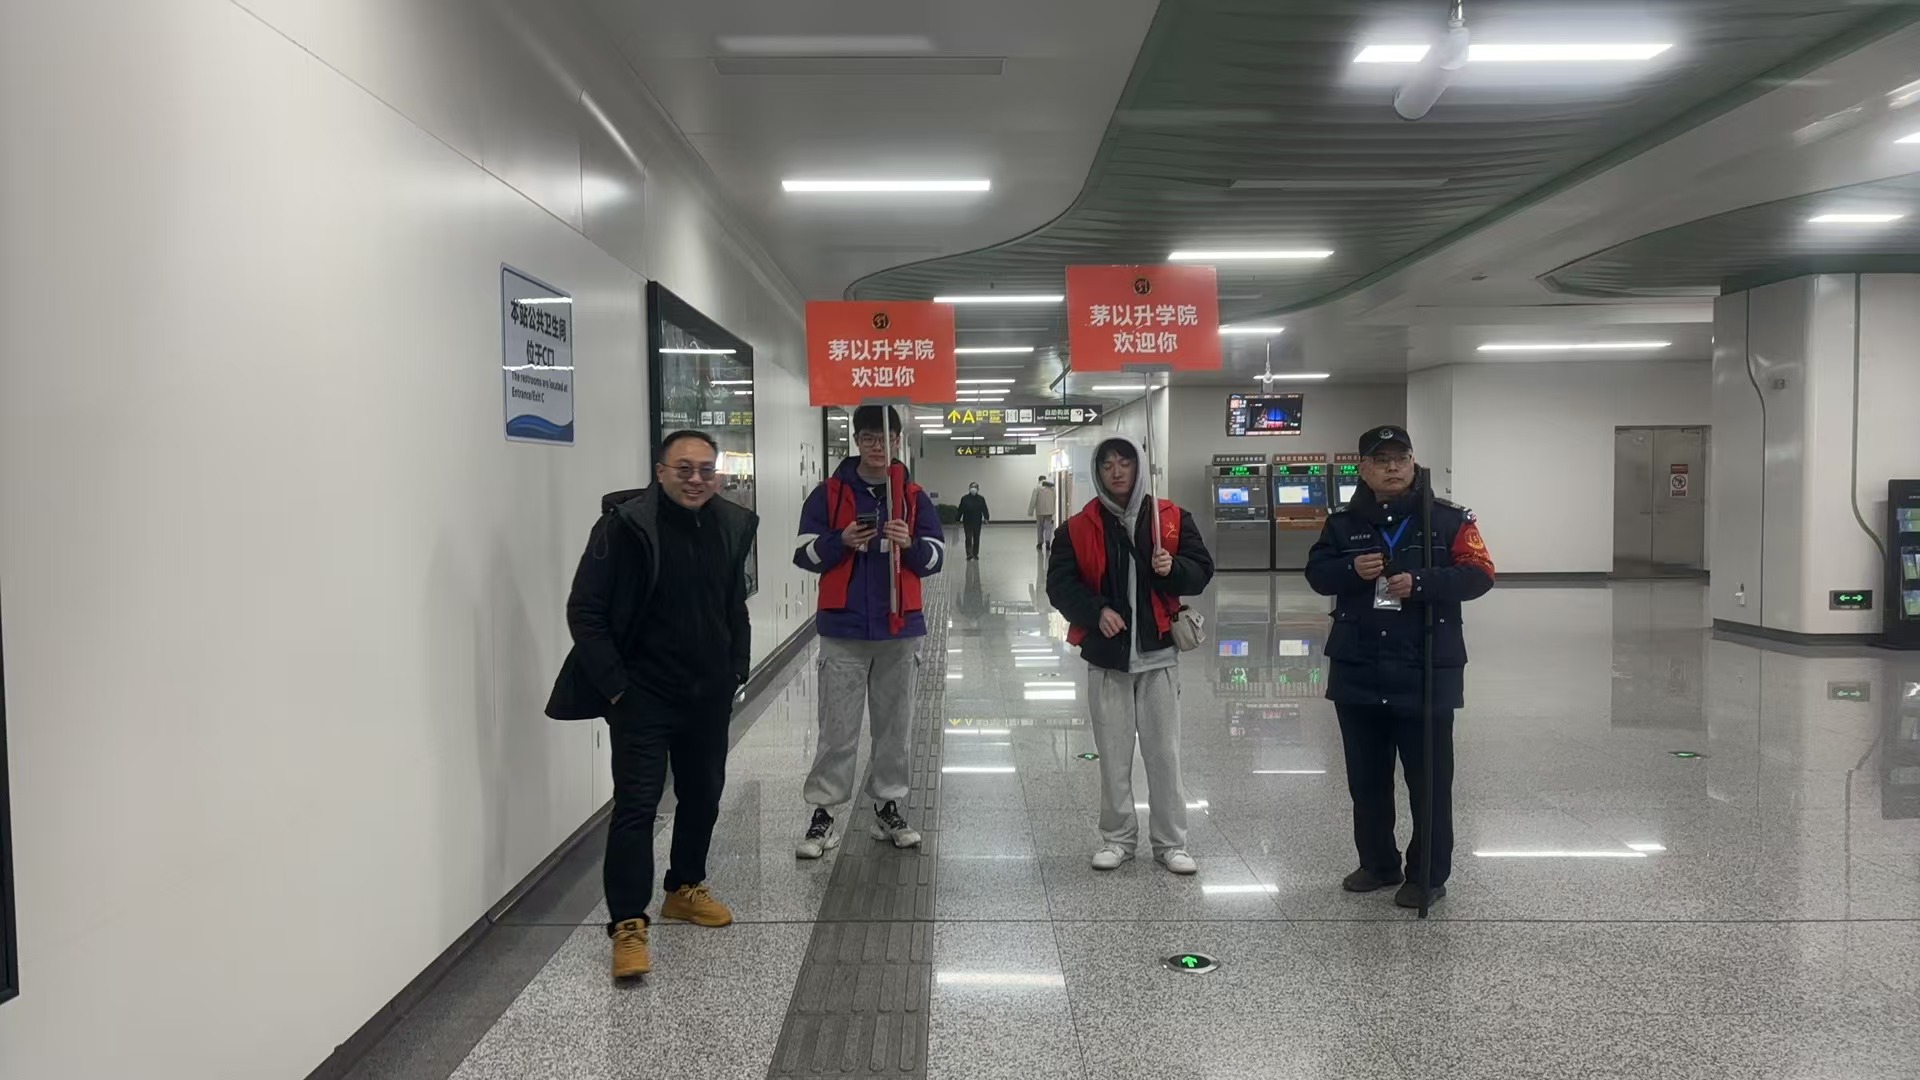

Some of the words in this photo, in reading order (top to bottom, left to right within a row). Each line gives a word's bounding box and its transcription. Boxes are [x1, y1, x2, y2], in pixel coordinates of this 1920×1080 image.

[510, 299, 566, 342] 本站公共卫生间
[1089, 304, 1198, 327] 茅以升学院
[526, 339, 555, 369] 位于C口
[828, 339, 935, 361] 茅以升学院
[1113, 331, 1178, 354] 欢迎你
[851, 365, 915, 388] 欢迎你
[962, 410, 975, 424] A
[964, 446, 973, 455] A
